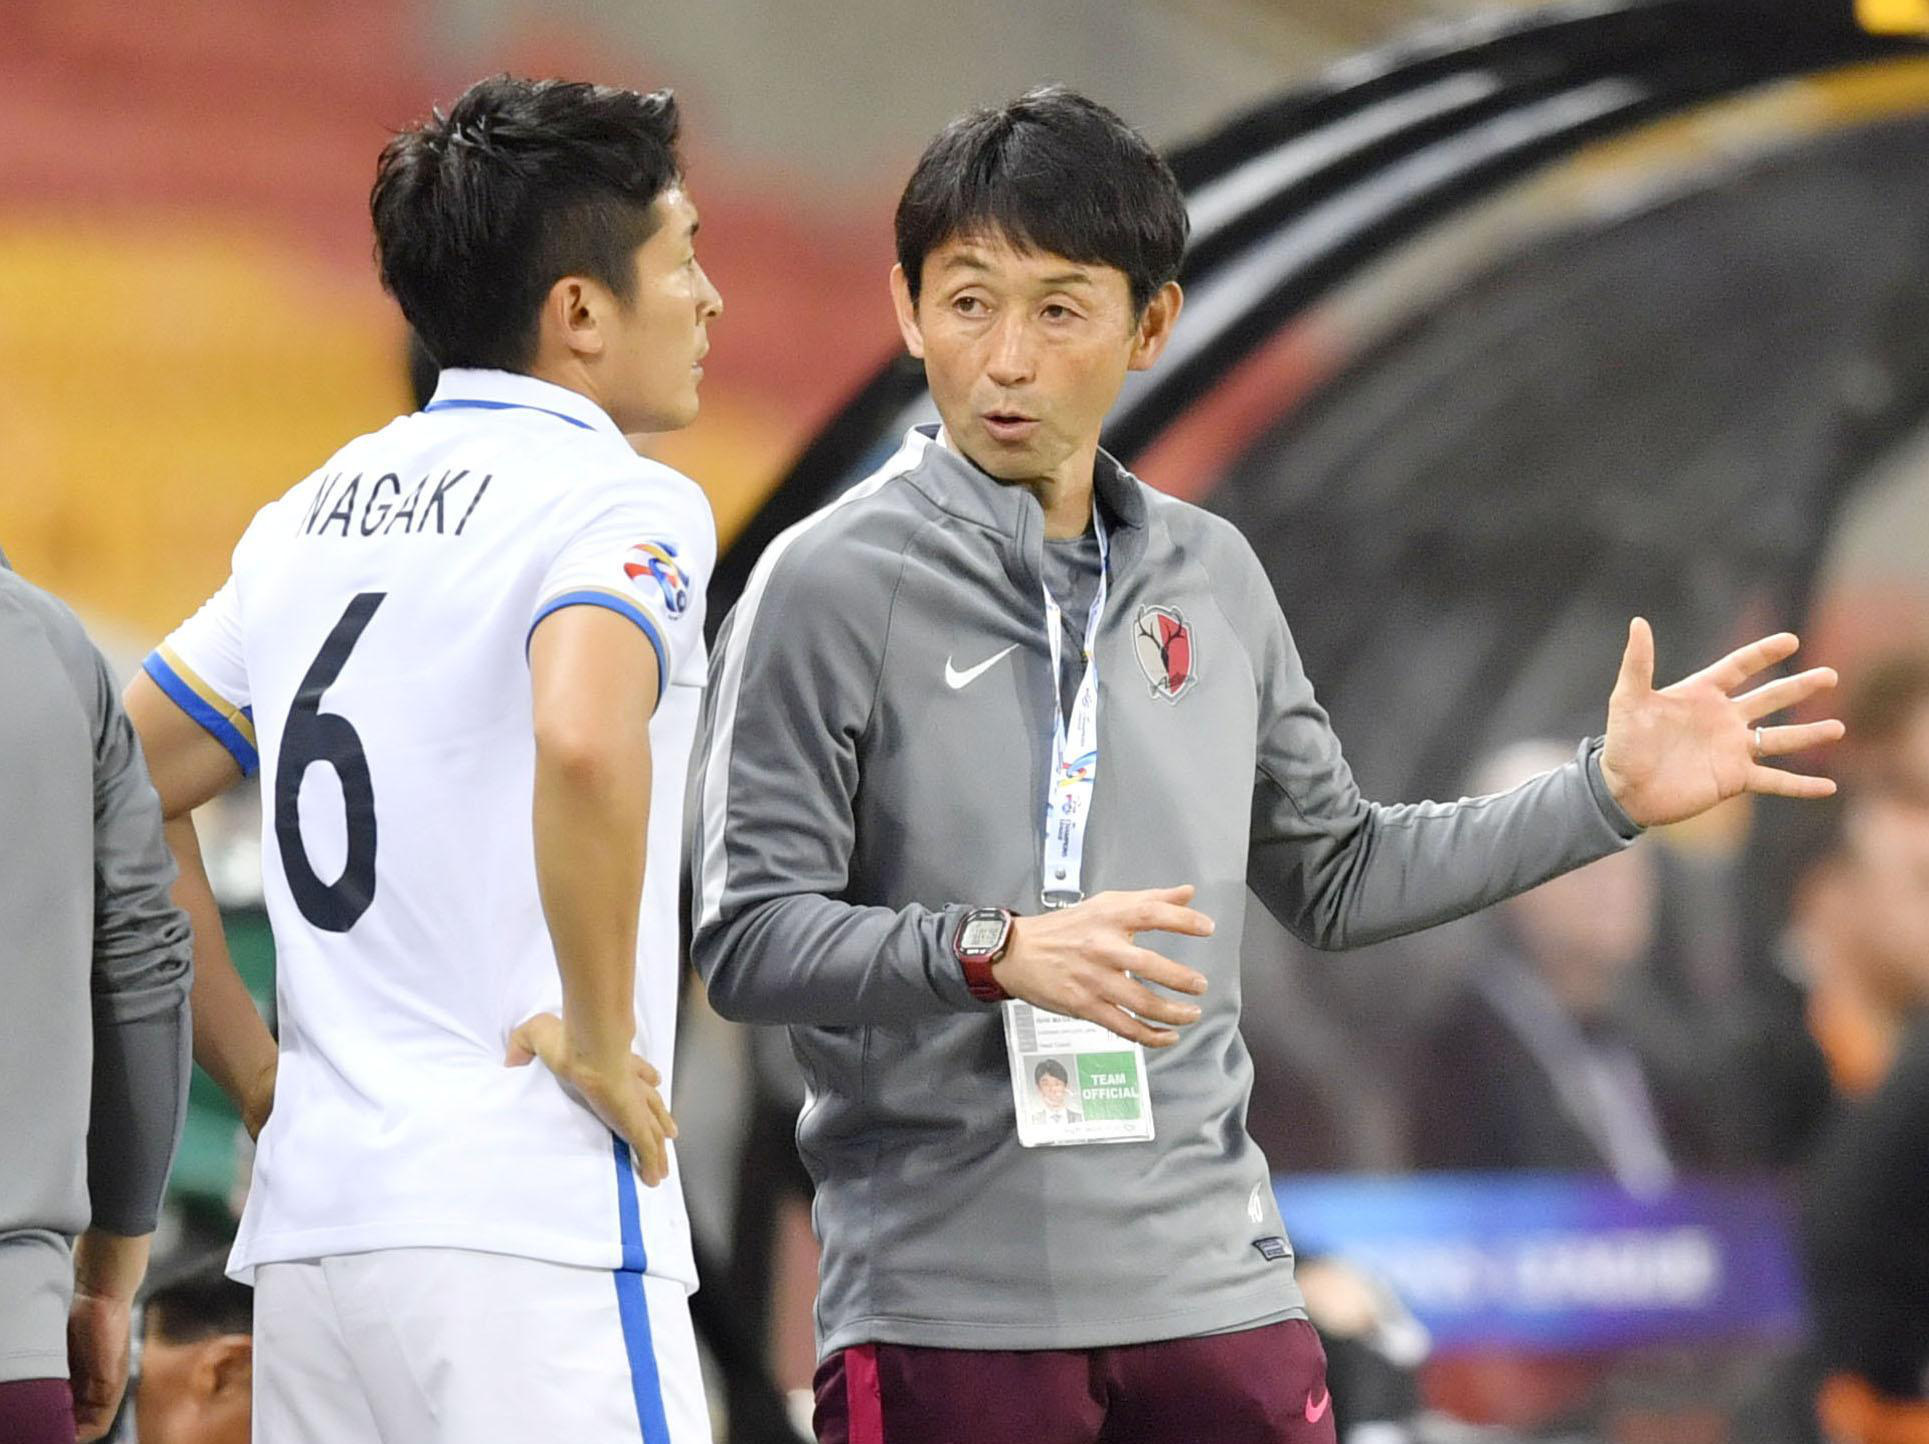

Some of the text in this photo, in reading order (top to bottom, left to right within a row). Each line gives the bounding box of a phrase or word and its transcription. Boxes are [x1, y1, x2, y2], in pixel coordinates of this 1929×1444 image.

[297, 468, 493, 538] NAGAKI
[274, 591, 388, 934] 6
[1082, 1087, 1140, 1100] OFFICIAL
[1090, 1072, 1127, 1086] TEAM
